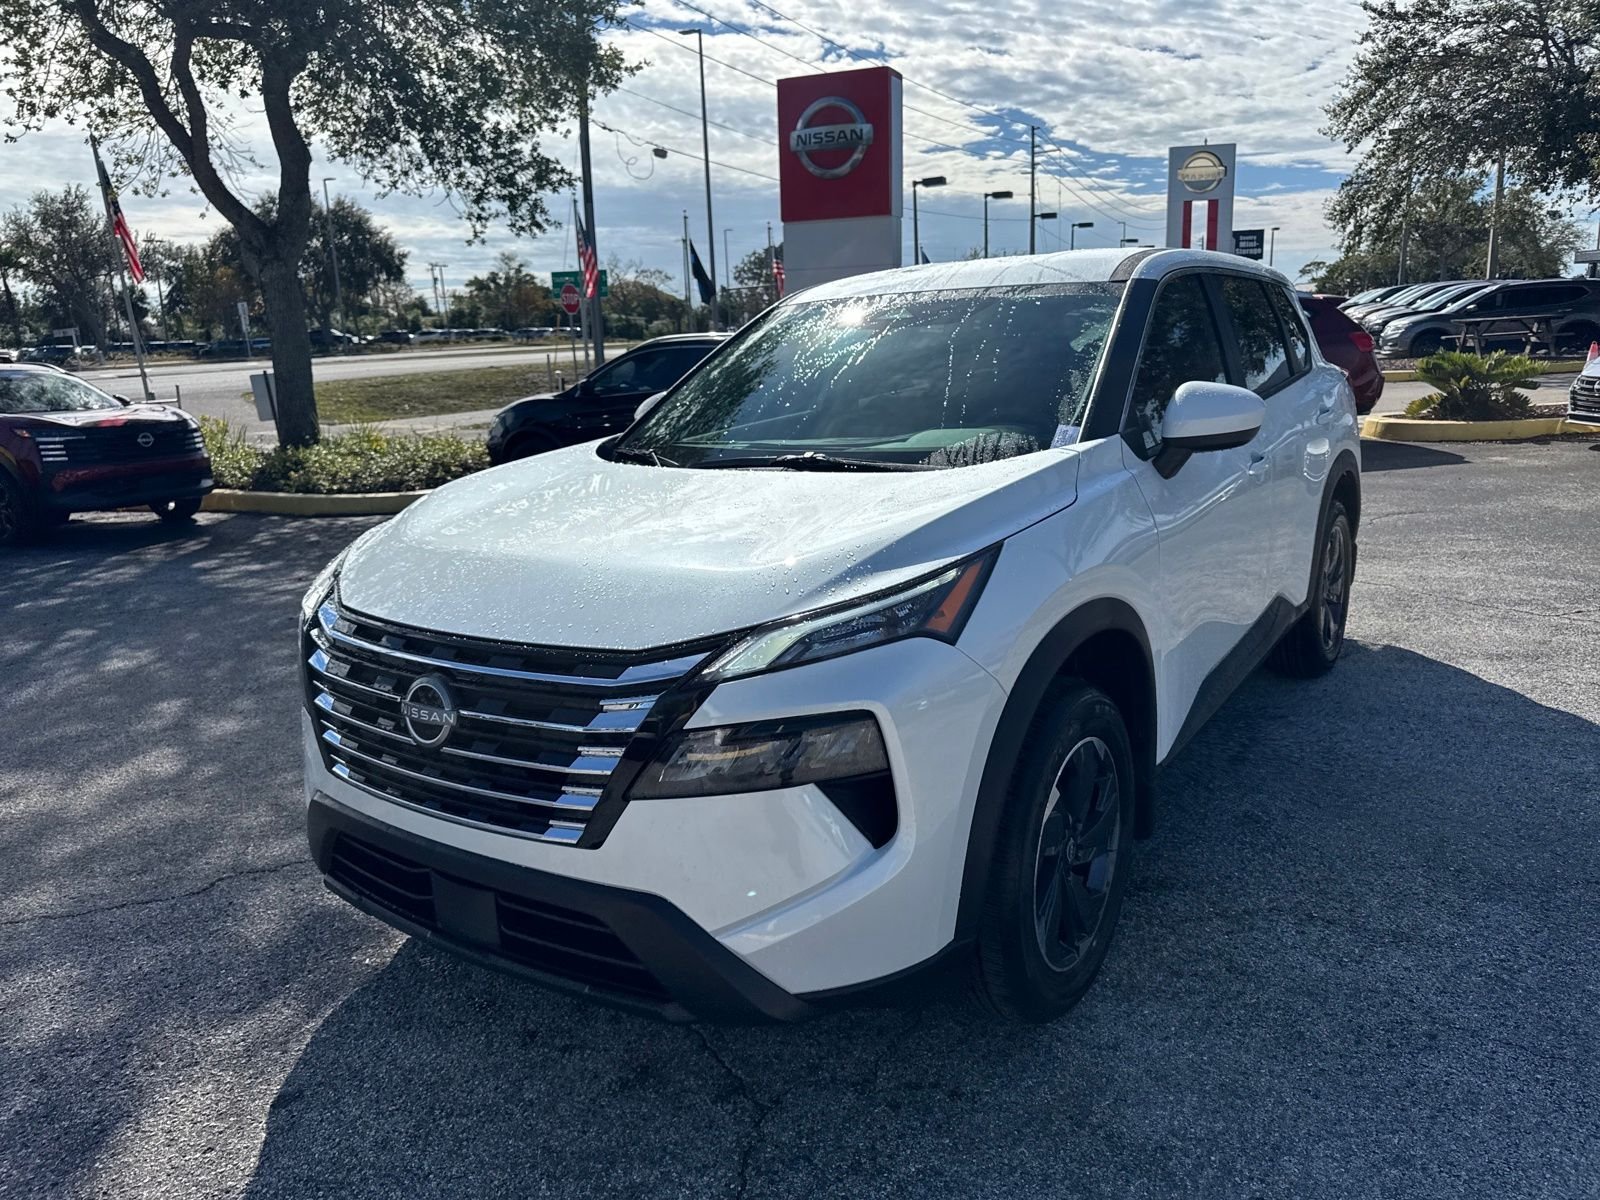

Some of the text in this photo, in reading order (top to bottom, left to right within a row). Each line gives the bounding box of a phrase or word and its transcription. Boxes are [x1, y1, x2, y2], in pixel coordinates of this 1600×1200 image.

[796, 128, 863, 147] NISSAN
[562, 293, 579, 305] STOP
[401, 702, 454, 723] NISSAN
